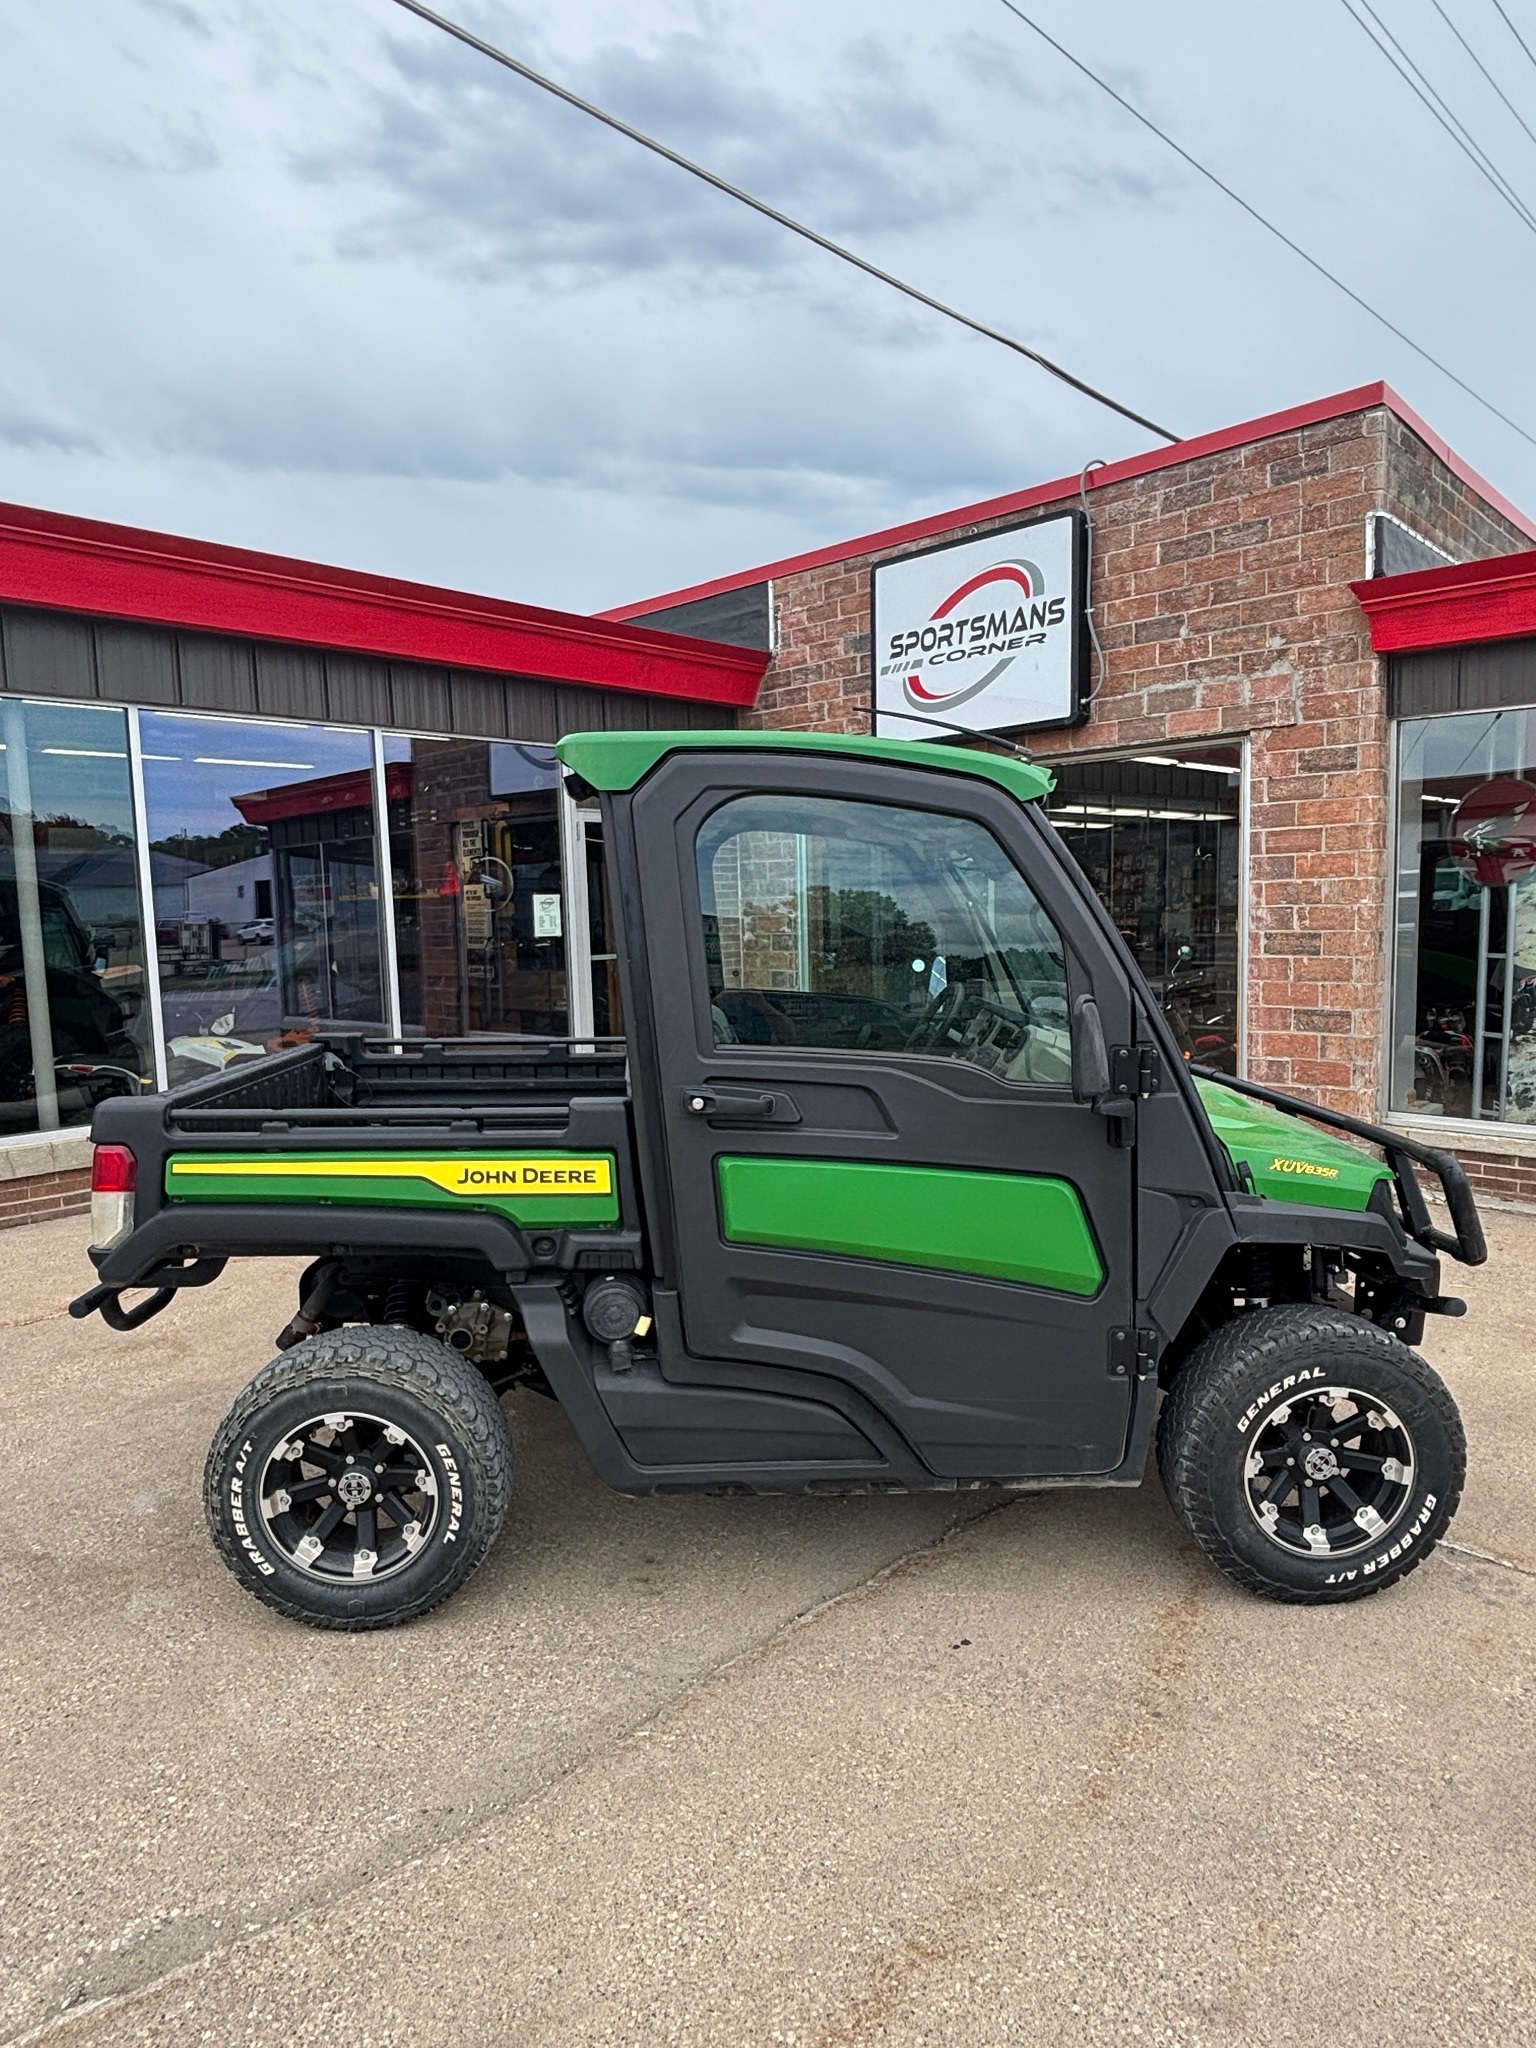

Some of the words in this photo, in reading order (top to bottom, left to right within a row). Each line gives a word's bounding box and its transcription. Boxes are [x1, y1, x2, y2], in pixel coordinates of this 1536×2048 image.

[889, 597, 1066, 660] SPORTSMANS
[928, 632, 1047, 666] CORNER
[457, 1168, 517, 1184] JOHN
[522, 1168, 597, 1184] DEERE
[1269, 1158, 1339, 1178] XUV835R
[1236, 1367, 1327, 1434] GENERAL
[235, 1439, 254, 1475] A/T
[434, 1443, 464, 1545] GENERAL
[230, 1477, 276, 1577] GRABBER
[1362, 1493, 1438, 1576] GRABBER
[1324, 1568, 1359, 1585] A/T
